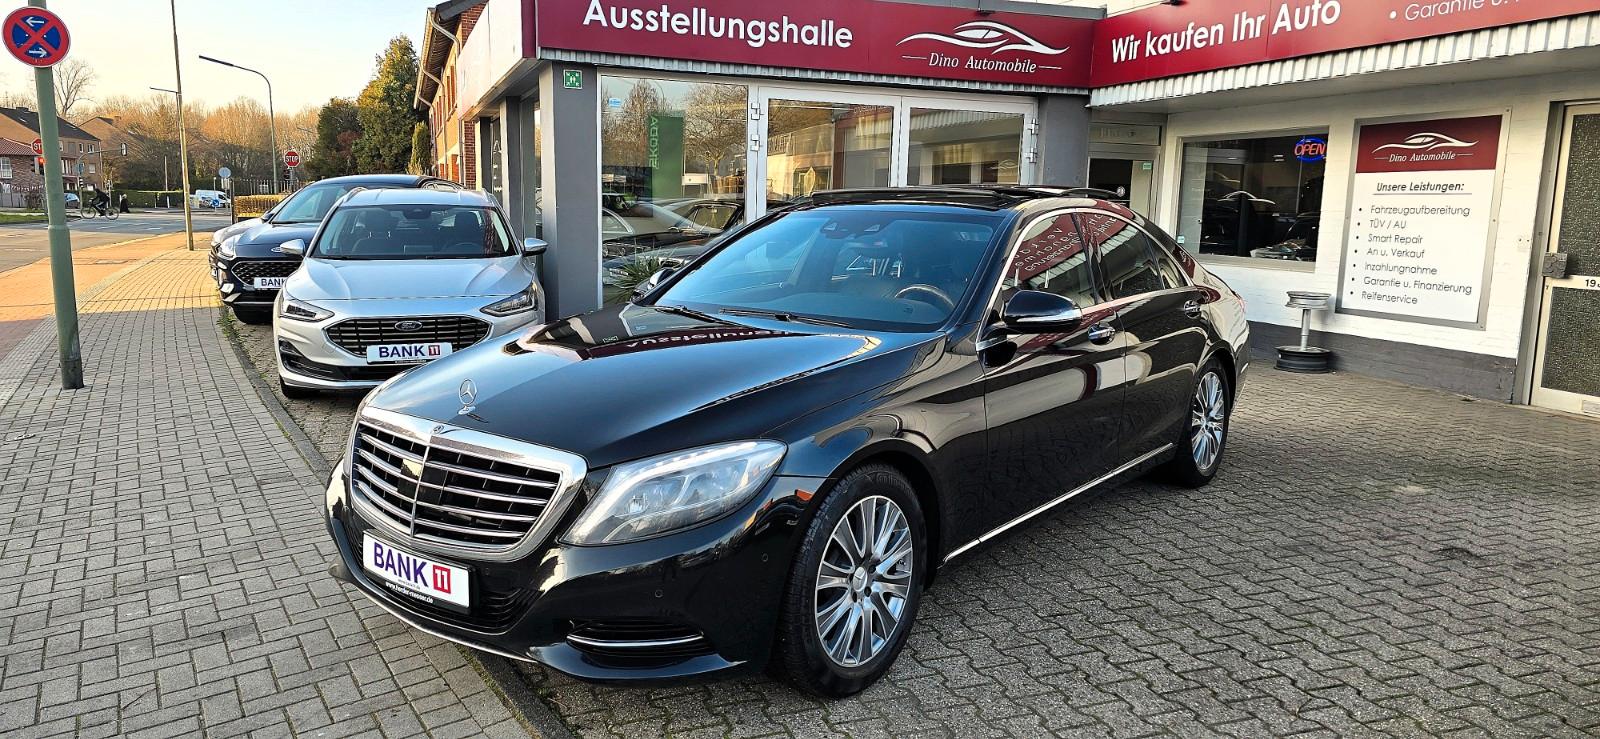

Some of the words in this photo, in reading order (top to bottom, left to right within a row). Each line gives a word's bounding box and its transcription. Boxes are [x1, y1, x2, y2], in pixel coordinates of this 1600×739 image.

[582, 0, 853, 48] Ausstellungshalle
[1112, 34, 1141, 63] Wir
[1145, 22, 1224, 57] kaufen
[1232, 11, 1266, 42] Ihr
[1271, 0, 1341, 35] Auto
[929, 52, 959, 68] Dino
[965, 55, 1037, 73] Automobile
[1294, 143, 1326, 156] OPEN
[285, 155, 299, 163] STOP
[1388, 153, 1407, 162] Dino
[1410, 151, 1456, 162] Automobile
[1376, 182, 1407, 192] Unsere
[1409, 181, 1465, 193] Leistungen:
[1370, 204, 1471, 217] Fahrzeugaufbereitung
[1369, 218, 1385, 229] TÜV
[1393, 219, 1407, 230] AU
[1367, 233, 1393, 243] Smart
[1394, 234, 1424, 245] Repair
[1366, 247, 1379, 256] An
[1391, 248, 1425, 259] Verkauf
[1363, 276, 1401, 287] Garantie
[1413, 280, 1473, 295] Finanzierung
[1361, 290, 1418, 305] Reifenservice
[379, 345, 426, 358] BANK
[429, 345, 440, 355] 11
[374, 541, 429, 588] BANK
[434, 566, 451, 592] 11
